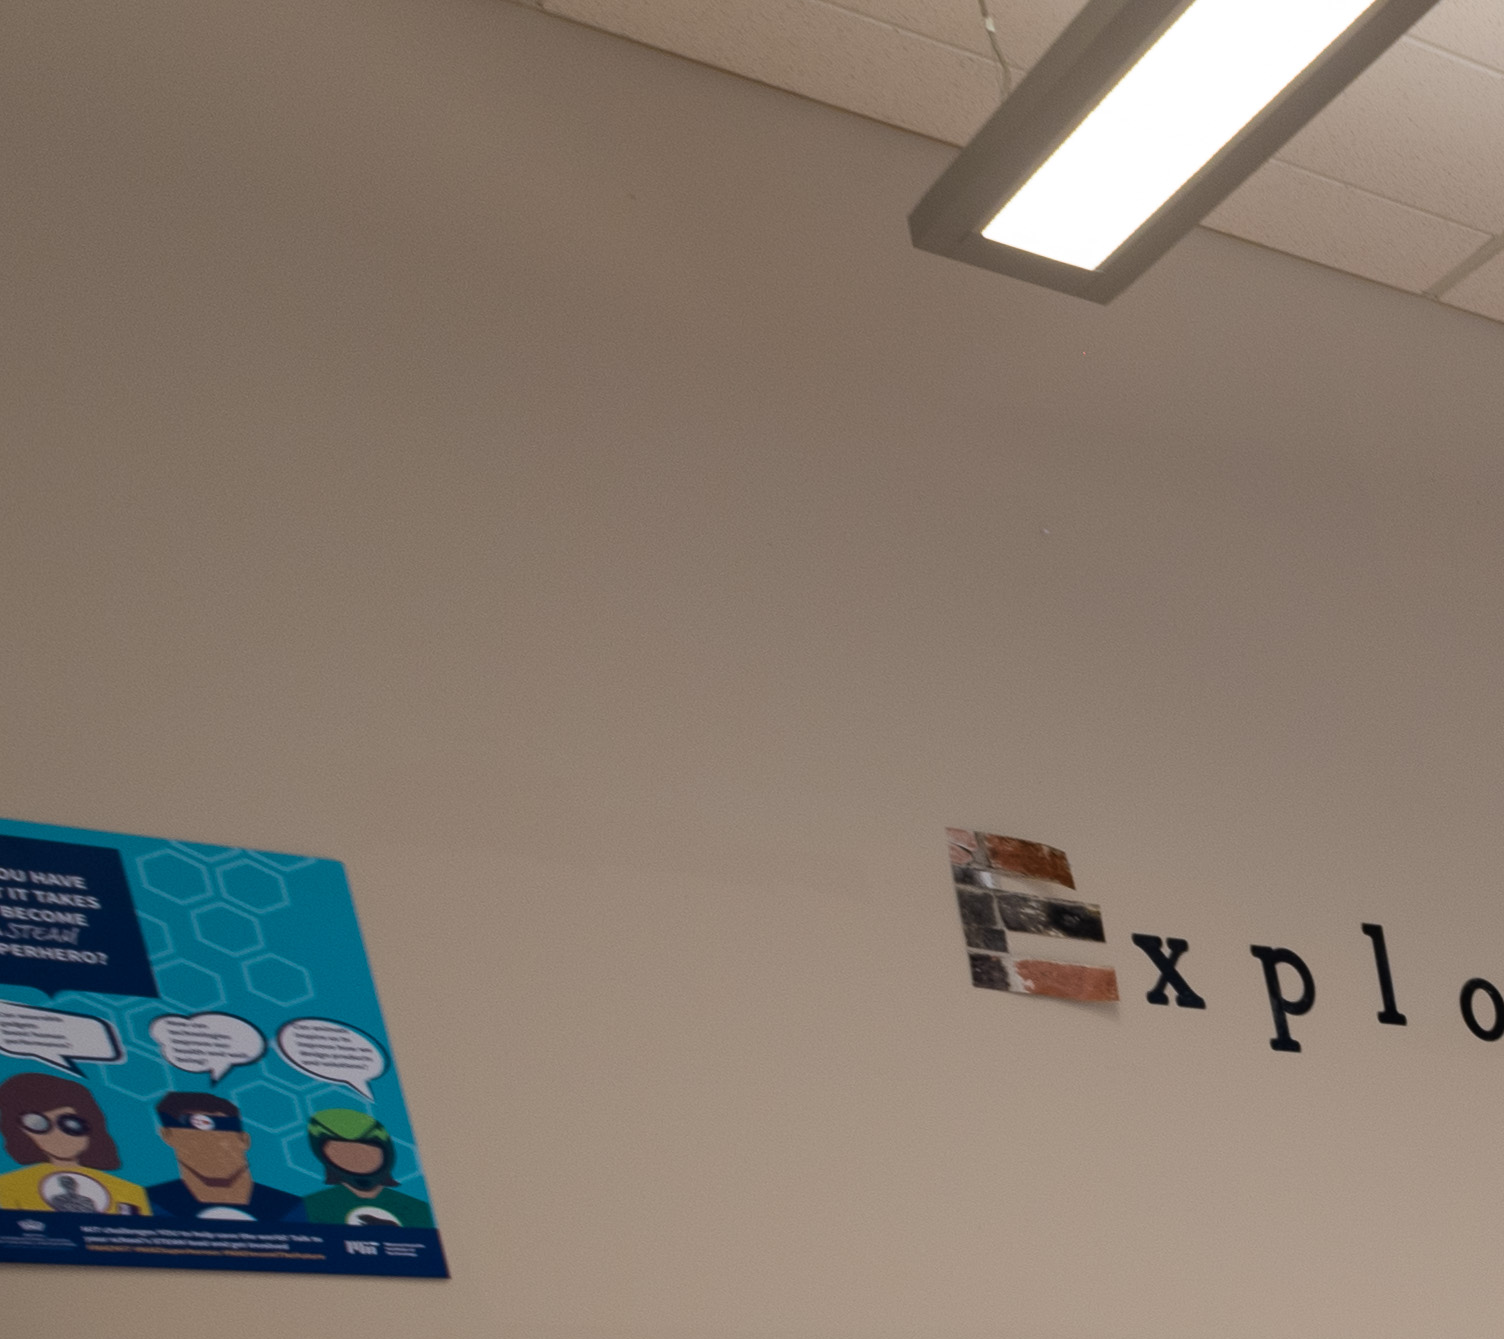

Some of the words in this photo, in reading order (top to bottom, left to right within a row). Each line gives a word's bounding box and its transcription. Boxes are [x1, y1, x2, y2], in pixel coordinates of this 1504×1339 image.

[29, 871, 88, 890] HAVE
[7, 887, 28, 901] IT
[31, 889, 102, 910] TAKES
